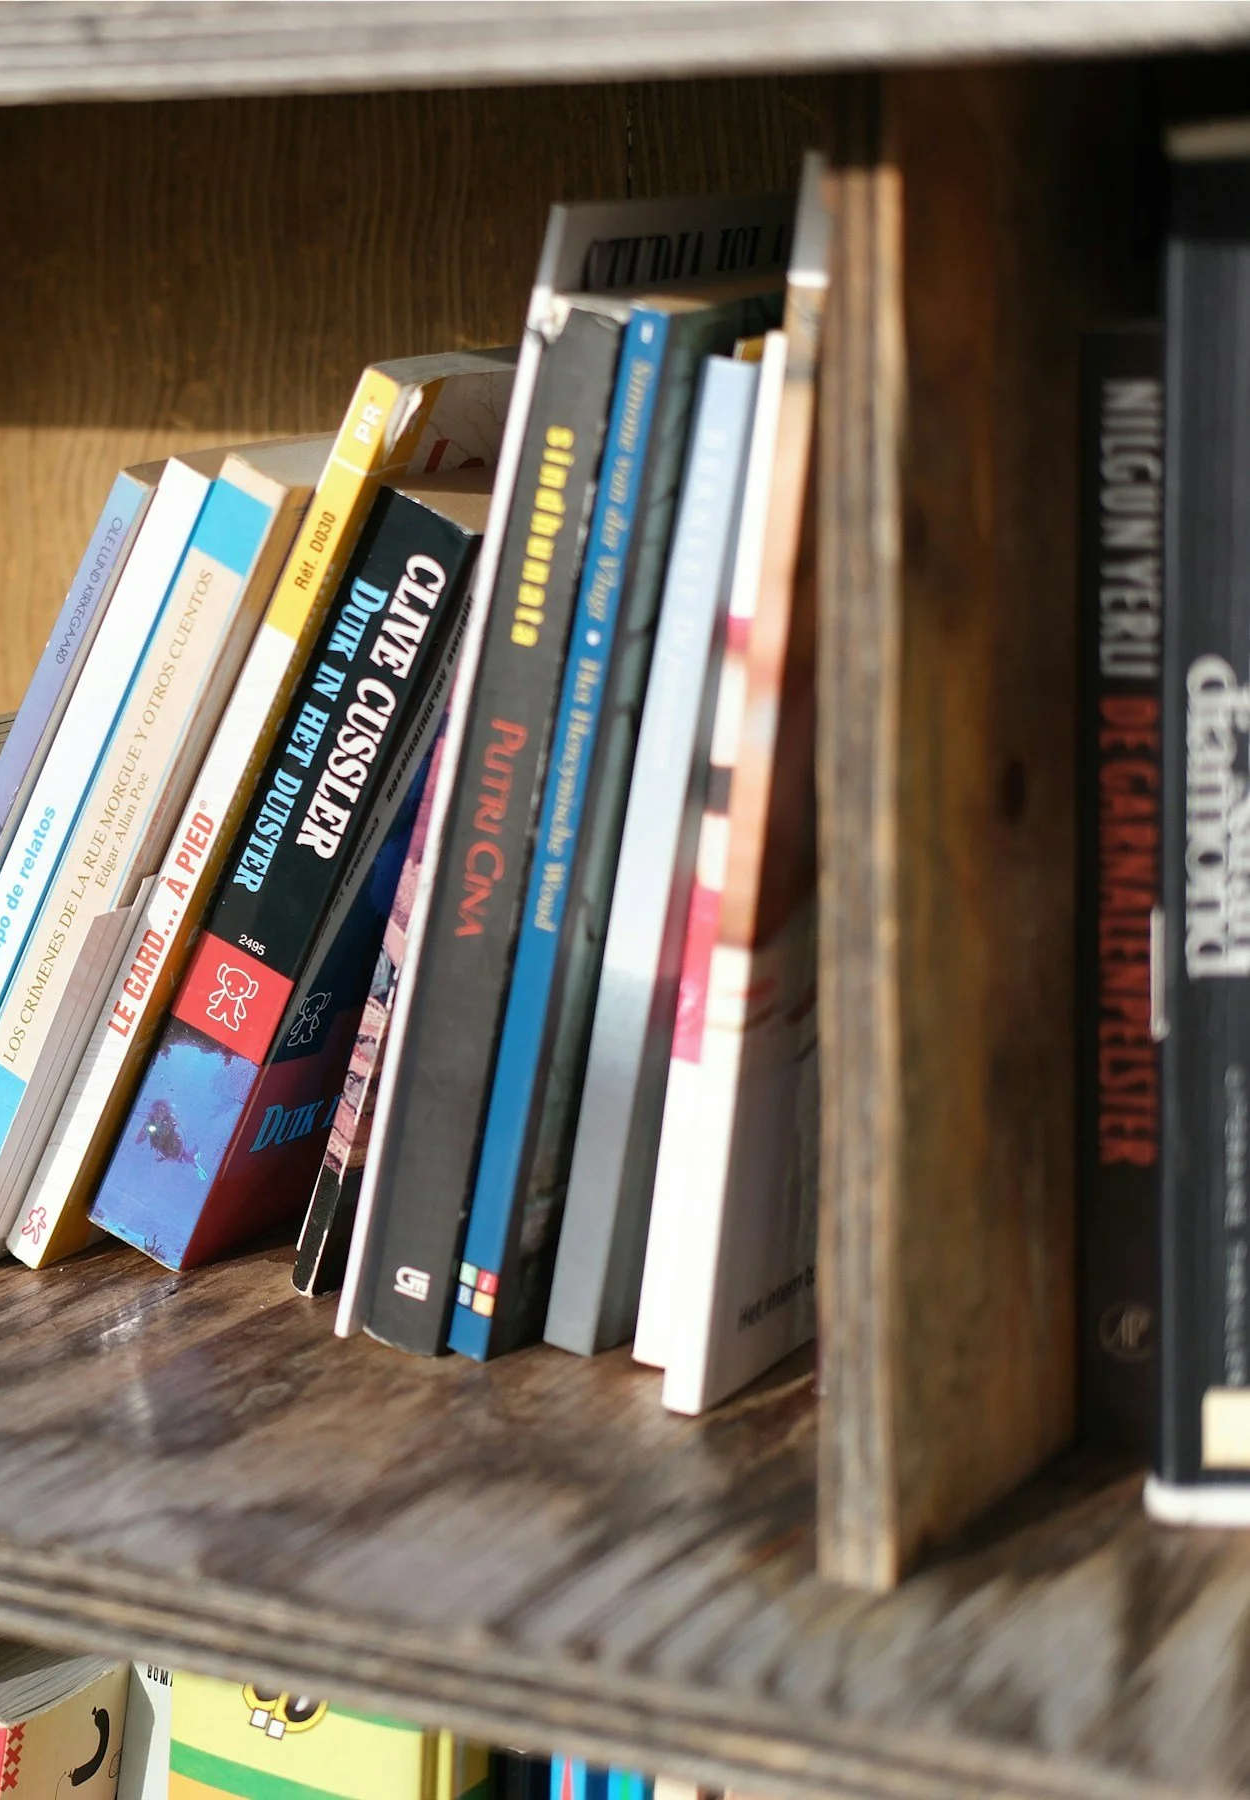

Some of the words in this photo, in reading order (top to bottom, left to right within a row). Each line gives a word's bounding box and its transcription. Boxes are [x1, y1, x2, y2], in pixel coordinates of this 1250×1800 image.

[619, 359, 653, 453] Simone
[610, 457, 633, 504] van
[89, 546, 110, 582] LUND
[106, 517, 123, 545] OLE
[308, 510, 336, 553] D030
[510, 425, 574, 646] sindhunata
[602, 507, 628, 551] der
[56, 585, 94, 664] KIRKEGAARD
[327, 575, 389, 662] DUIK
[370, 553, 447, 681] CLIVE
[312, 660, 347, 703] IN
[574, 658, 602, 705] Het
[286, 701, 330, 768] HET
[1099, 697, 1159, 752] DE
[295, 676, 398, 860] CUSSLER
[472, 717, 527, 835] PUTRI
[2, 1025, 27, 1063] LOS
[20, 929, 66, 1023] CRÍMENES
[59, 899, 79, 931] DE
[71, 871, 91, 900] LA
[82, 827, 108, 867] RUE
[100, 745, 141, 831] MORGUE
[134, 725, 148, 745] Y
[142, 660, 178, 727] OTROS
[171, 567, 213, 662] CUENTOS
[94, 846, 119, 888] Edgar
[114, 802, 138, 843] Allan
[131, 771, 150, 800] Poe
[233, 769, 302, 893] DUISTER
[6, 882, 26, 910] de
[21, 805, 57, 878] relatos
[537, 864, 565, 932] Woud
[107, 1001, 136, 1038] LE
[123, 908, 180, 1002] GARD...
[159, 875, 190, 901] À
[238, 934, 266, 957] 2495
[249, 1100, 323, 1153] DUIK
[321, 1093, 342, 1129] I
